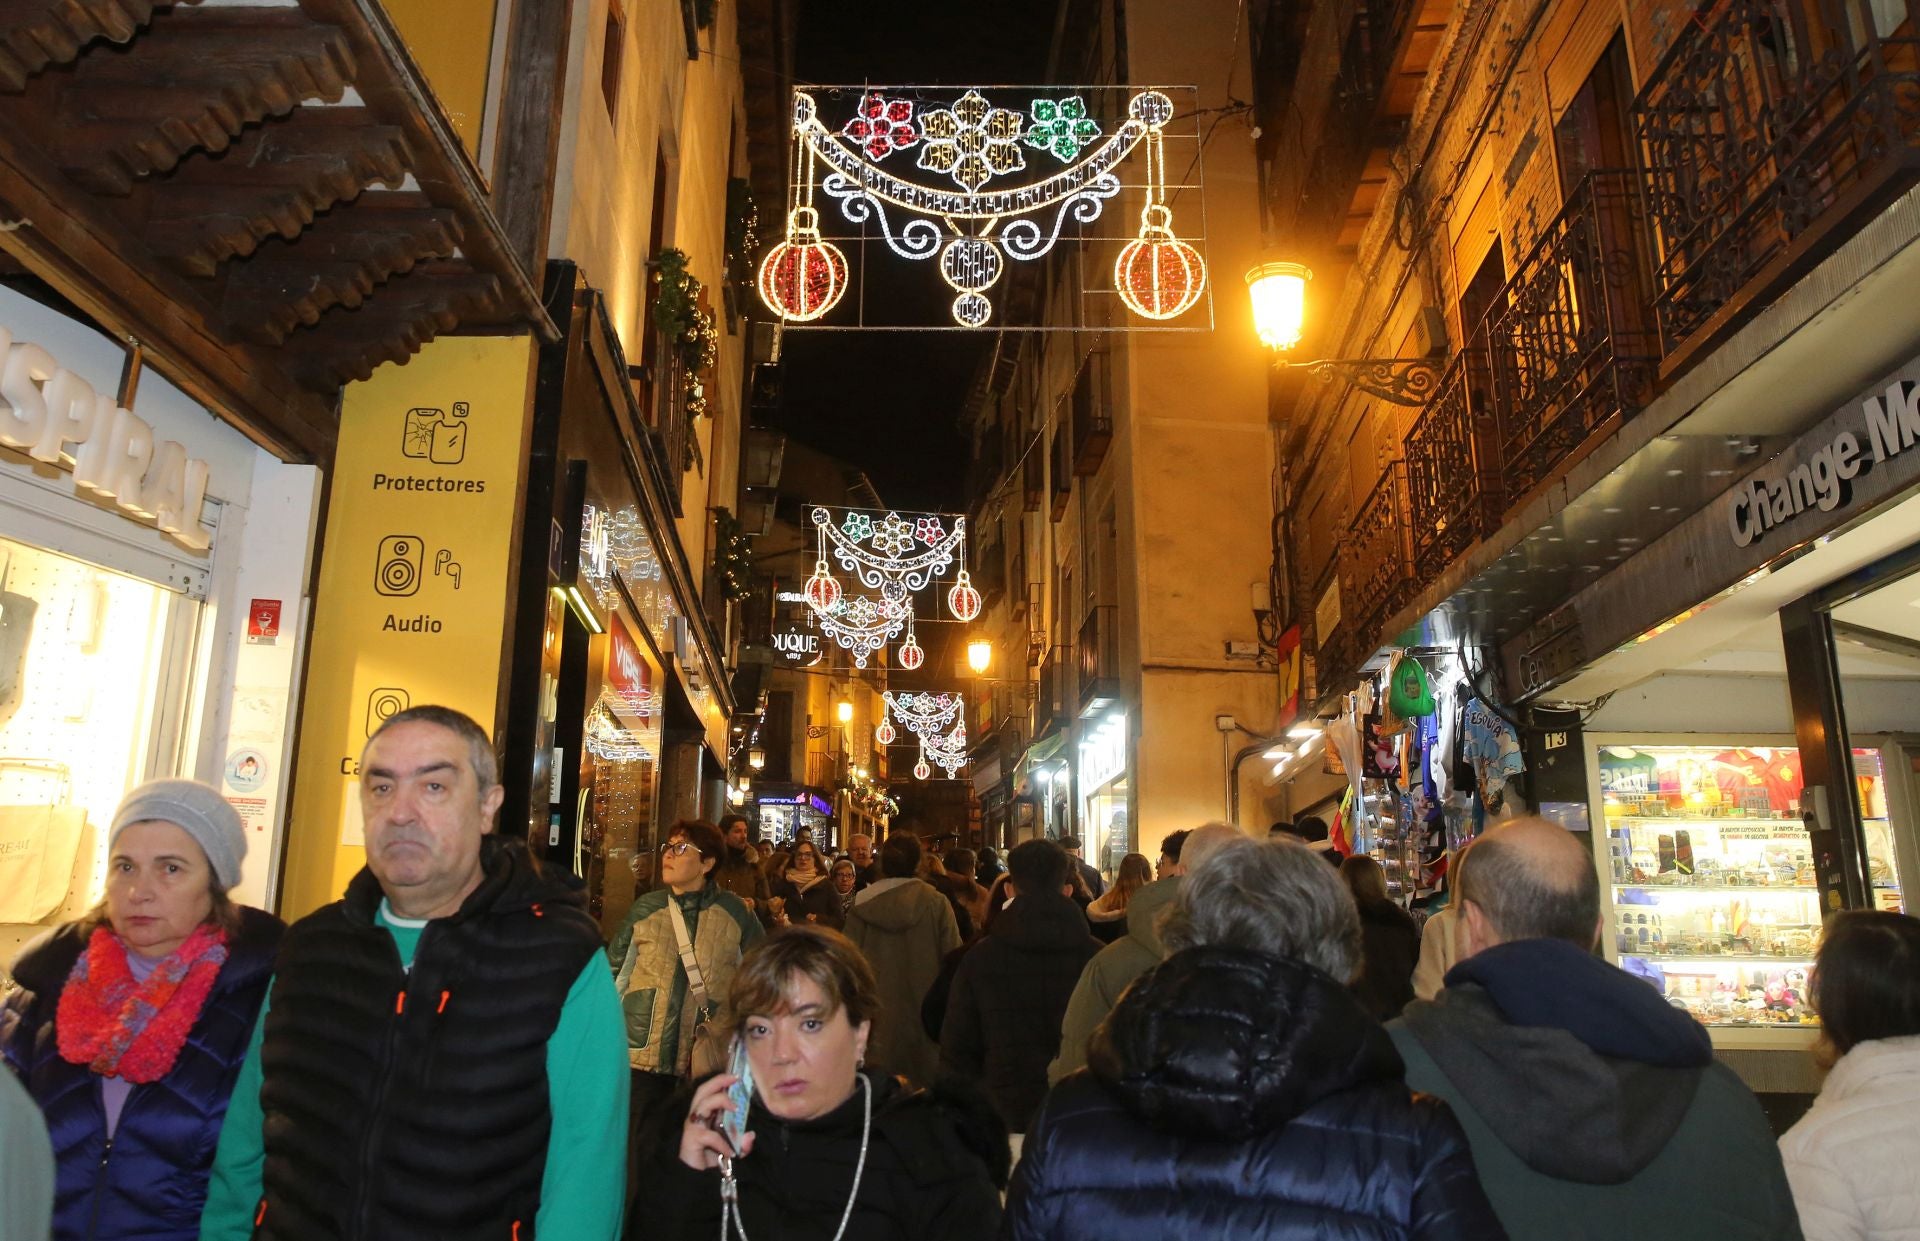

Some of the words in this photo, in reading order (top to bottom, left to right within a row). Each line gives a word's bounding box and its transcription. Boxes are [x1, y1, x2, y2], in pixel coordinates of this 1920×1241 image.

[0, 326, 210, 550] SPIRAL
[373, 473, 486, 493] Protectores
[1729, 431, 1861, 548] Change
[382, 614, 442, 633] Audio
[1547, 731, 1565, 748] 13
